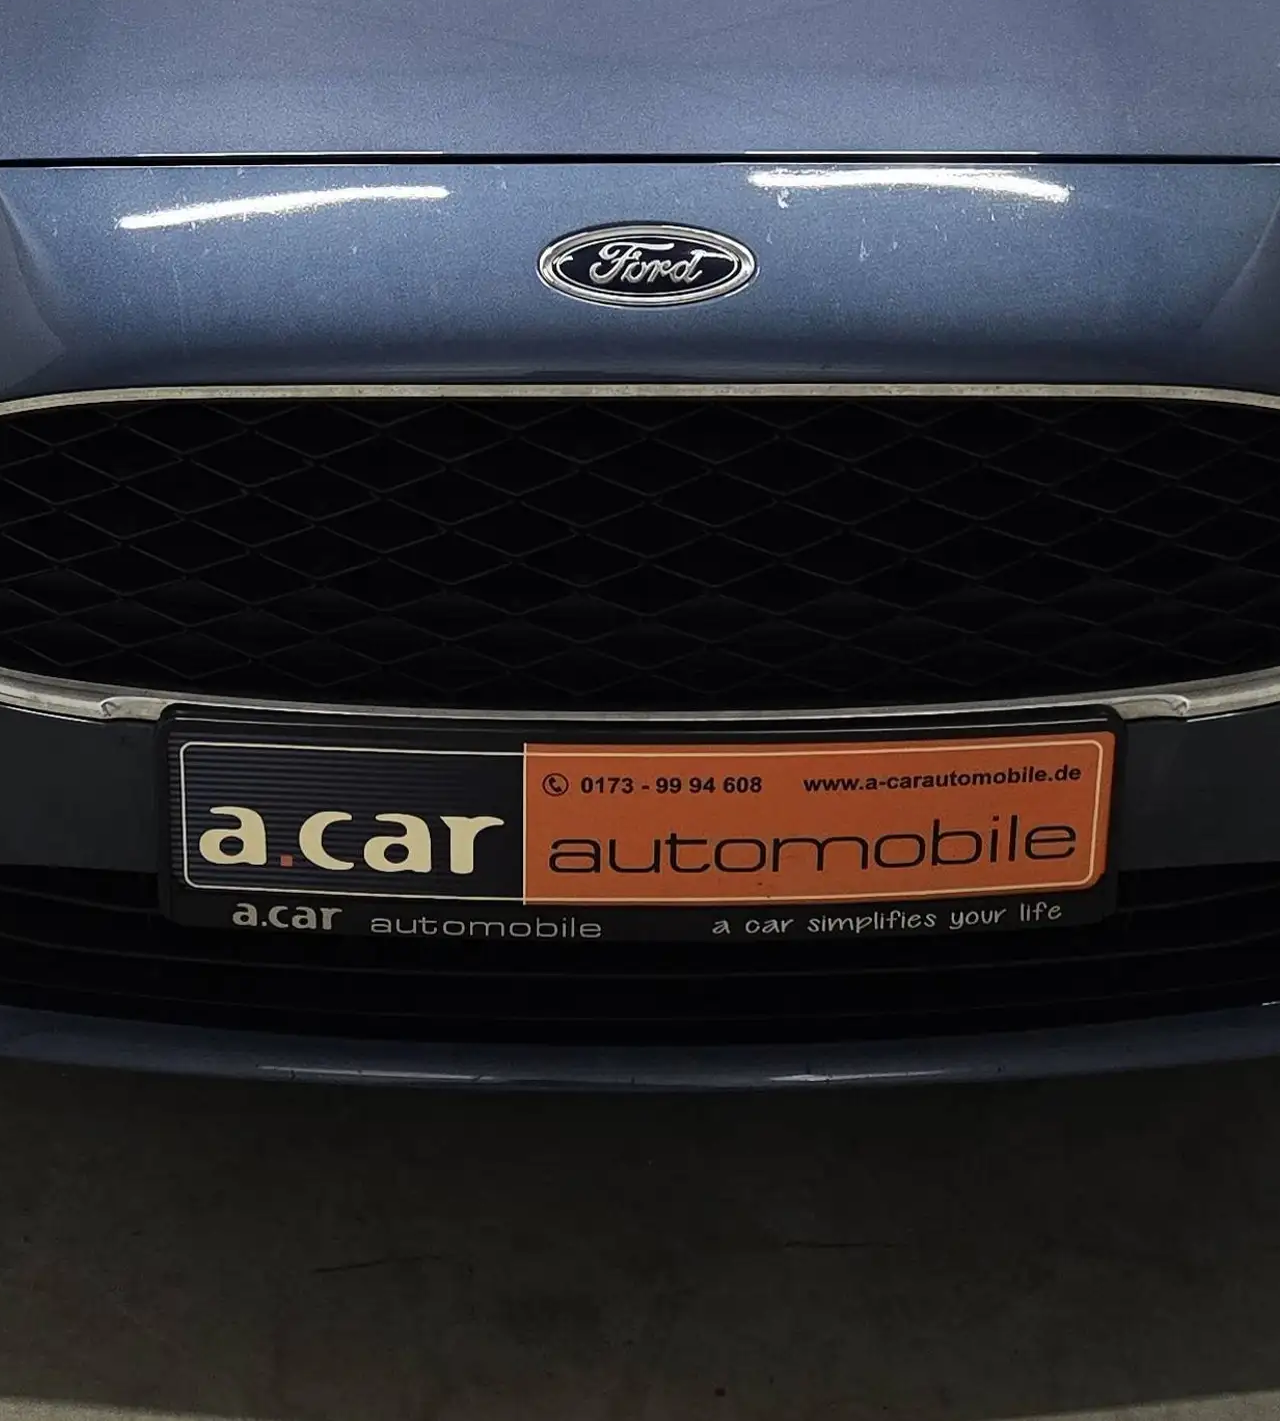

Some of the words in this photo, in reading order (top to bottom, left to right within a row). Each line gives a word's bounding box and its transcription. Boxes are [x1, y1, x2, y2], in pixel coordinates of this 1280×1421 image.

[589, 240, 710, 286] Ford
[580, 776, 635, 794] 0173
[655, 776, 682, 794] 99
[688, 776, 716, 794] 94
[722, 776, 763, 794] 608
[803, 764, 1082, 793] www.a-carautomobile.de
[199, 805, 505, 875] a.car
[548, 814, 1077, 875] automobile
[232, 902, 343, 930] a.car
[370, 915, 603, 939] automobile
[711, 919, 731, 935] a
[744, 917, 796, 935] car
[806, 909, 938, 934] simplifies
[948, 907, 1008, 930] your
[1019, 901, 1063, 923] life
